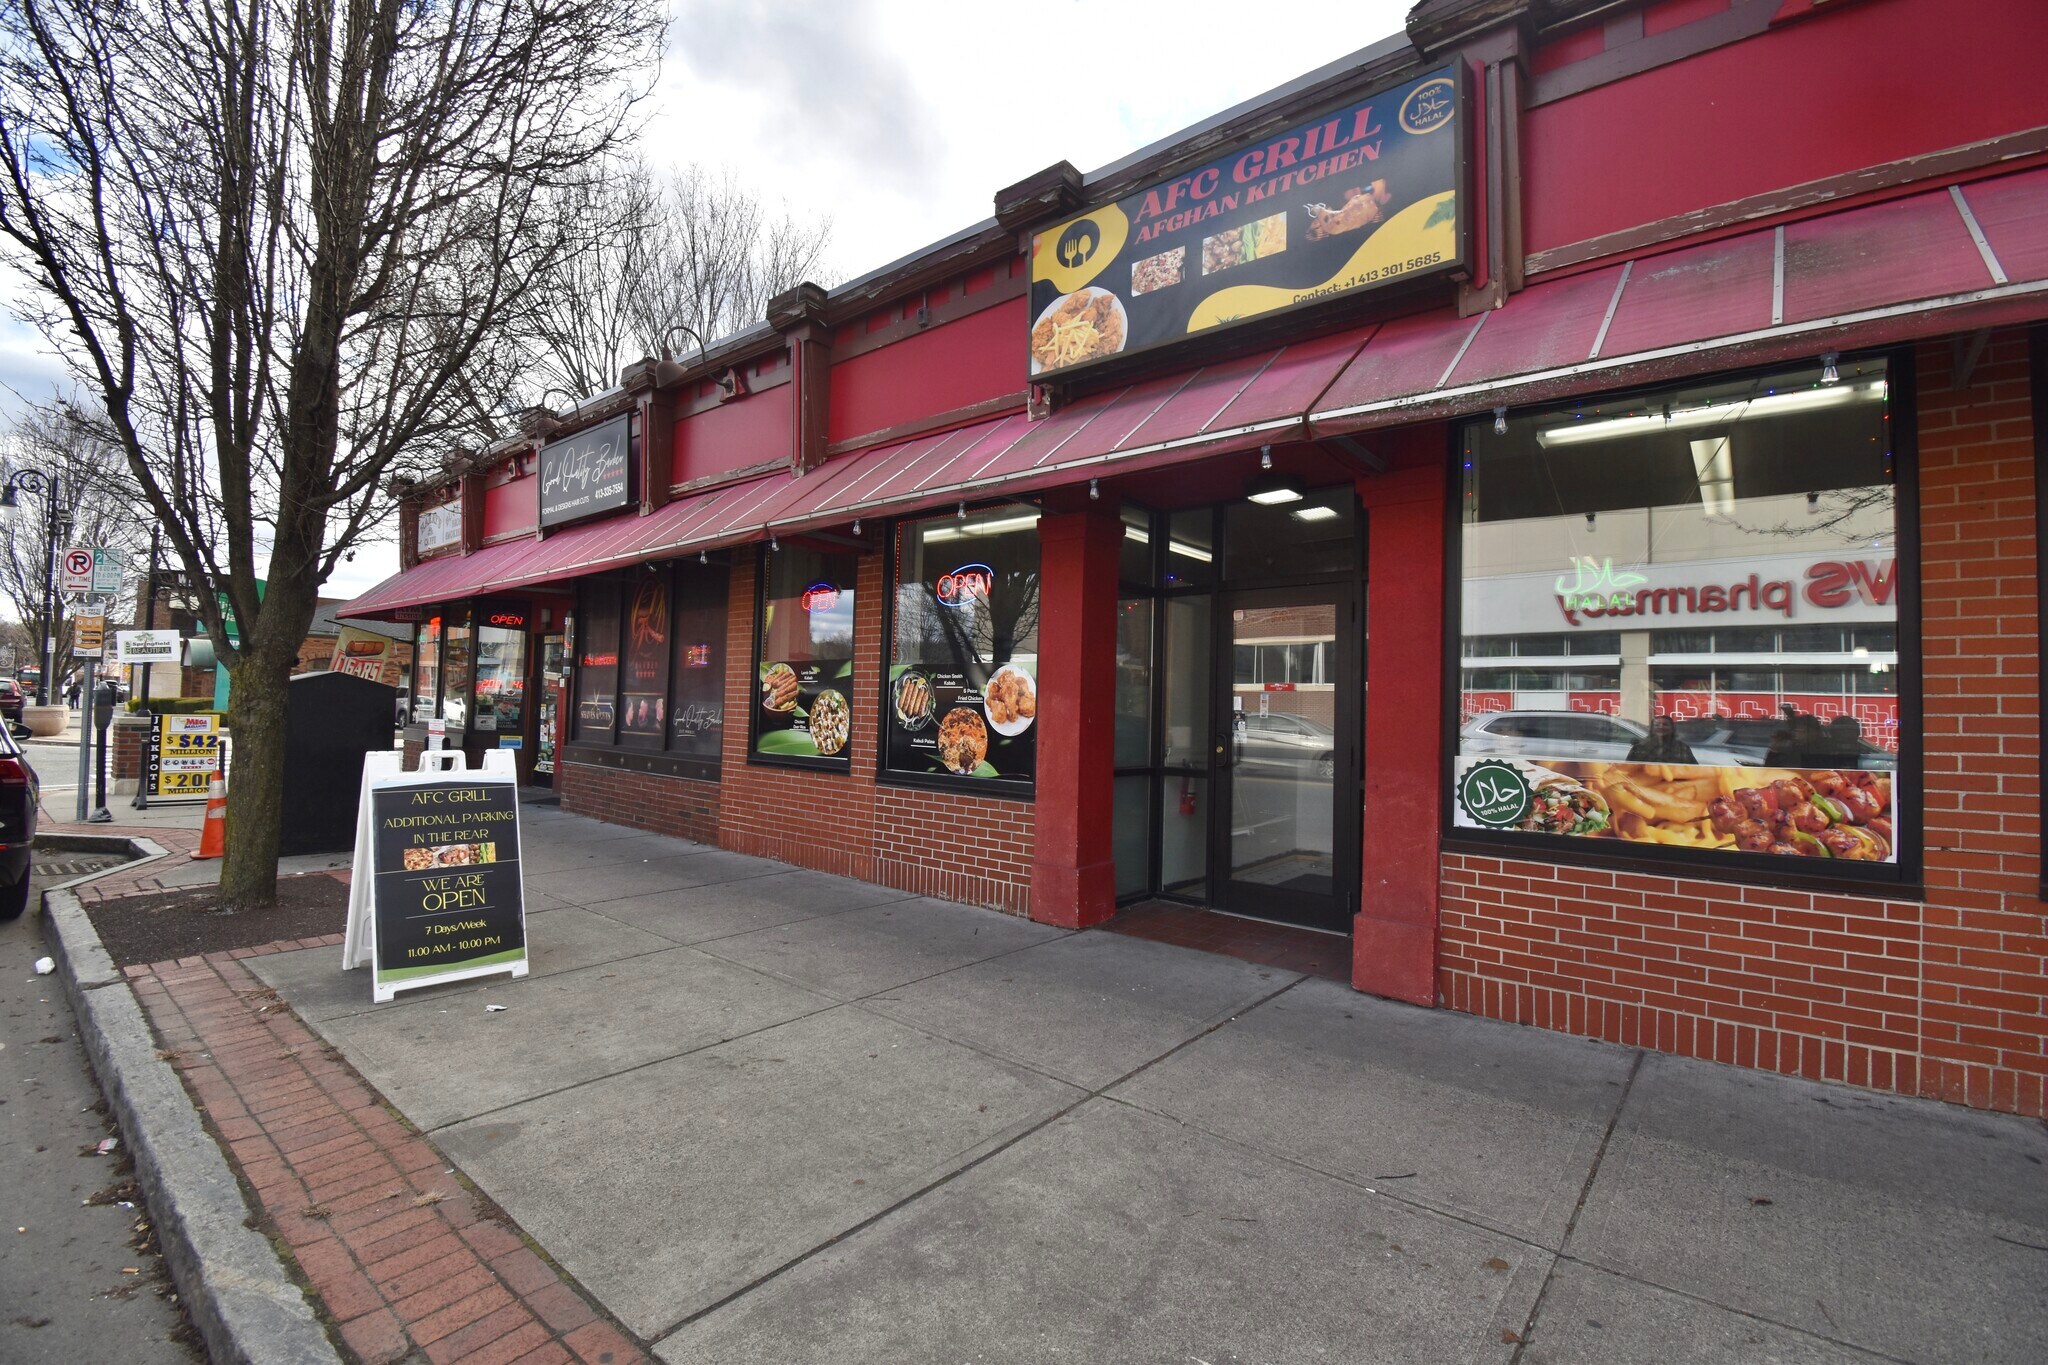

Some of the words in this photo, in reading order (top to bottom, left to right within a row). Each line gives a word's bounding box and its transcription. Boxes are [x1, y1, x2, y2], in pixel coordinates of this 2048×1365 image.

[1418, 85, 1442, 101] 100%
[1410, 98, 1450, 120] حلال
[1415, 111, 1444, 126] HALAL
[1133, 168, 1220, 224] AFC
[1232, 106, 1382, 184] GRILL
[1134, 192, 1241, 245] AFGHAN
[1244, 140, 1382, 205] KITCHEN
[1293, 283, 1342, 304] Contact:
[1344, 277, 1355, 288] +1
[1358, 270, 1379, 284] 413
[1381, 262, 1403, 277] 301
[1406, 251, 1441, 270] 5685
[96, 553, 103, 565] 2
[937, 573, 992, 598] OPEN
[1555, 557, 1648, 594] حلال
[802, 589, 838, 610] OPEN
[1564, 593, 1634, 609] HALAL
[490, 615, 523, 625] OPEN
[334, 654, 380, 682] CIGARS
[149, 716, 160, 790] JACKPOTS
[411, 792, 444, 805] AFC
[448, 789, 492, 803] GRILL
[1472, 776, 1520, 808] حلال
[384, 814, 460, 829] ADDITIONAL
[462, 811, 514, 823] PARKING
[1481, 808, 1498, 816] 100%
[1497, 803, 1519, 813] HALAL
[414, 834, 425, 844] IN
[427, 832, 452, 842] THE
[454, 829, 489, 841] REAR
[422, 877, 451, 891] WE
[455, 873, 485, 889] ARE
[422, 887, 486, 911] OPEN
[425, 926, 431, 935] 7
[434, 919, 487, 934] Days/Week
[408, 946, 430, 957] 11.00
[432, 943, 451, 954] AM
[459, 938, 482, 950] 10.00
[484, 935, 501, 946] PM
